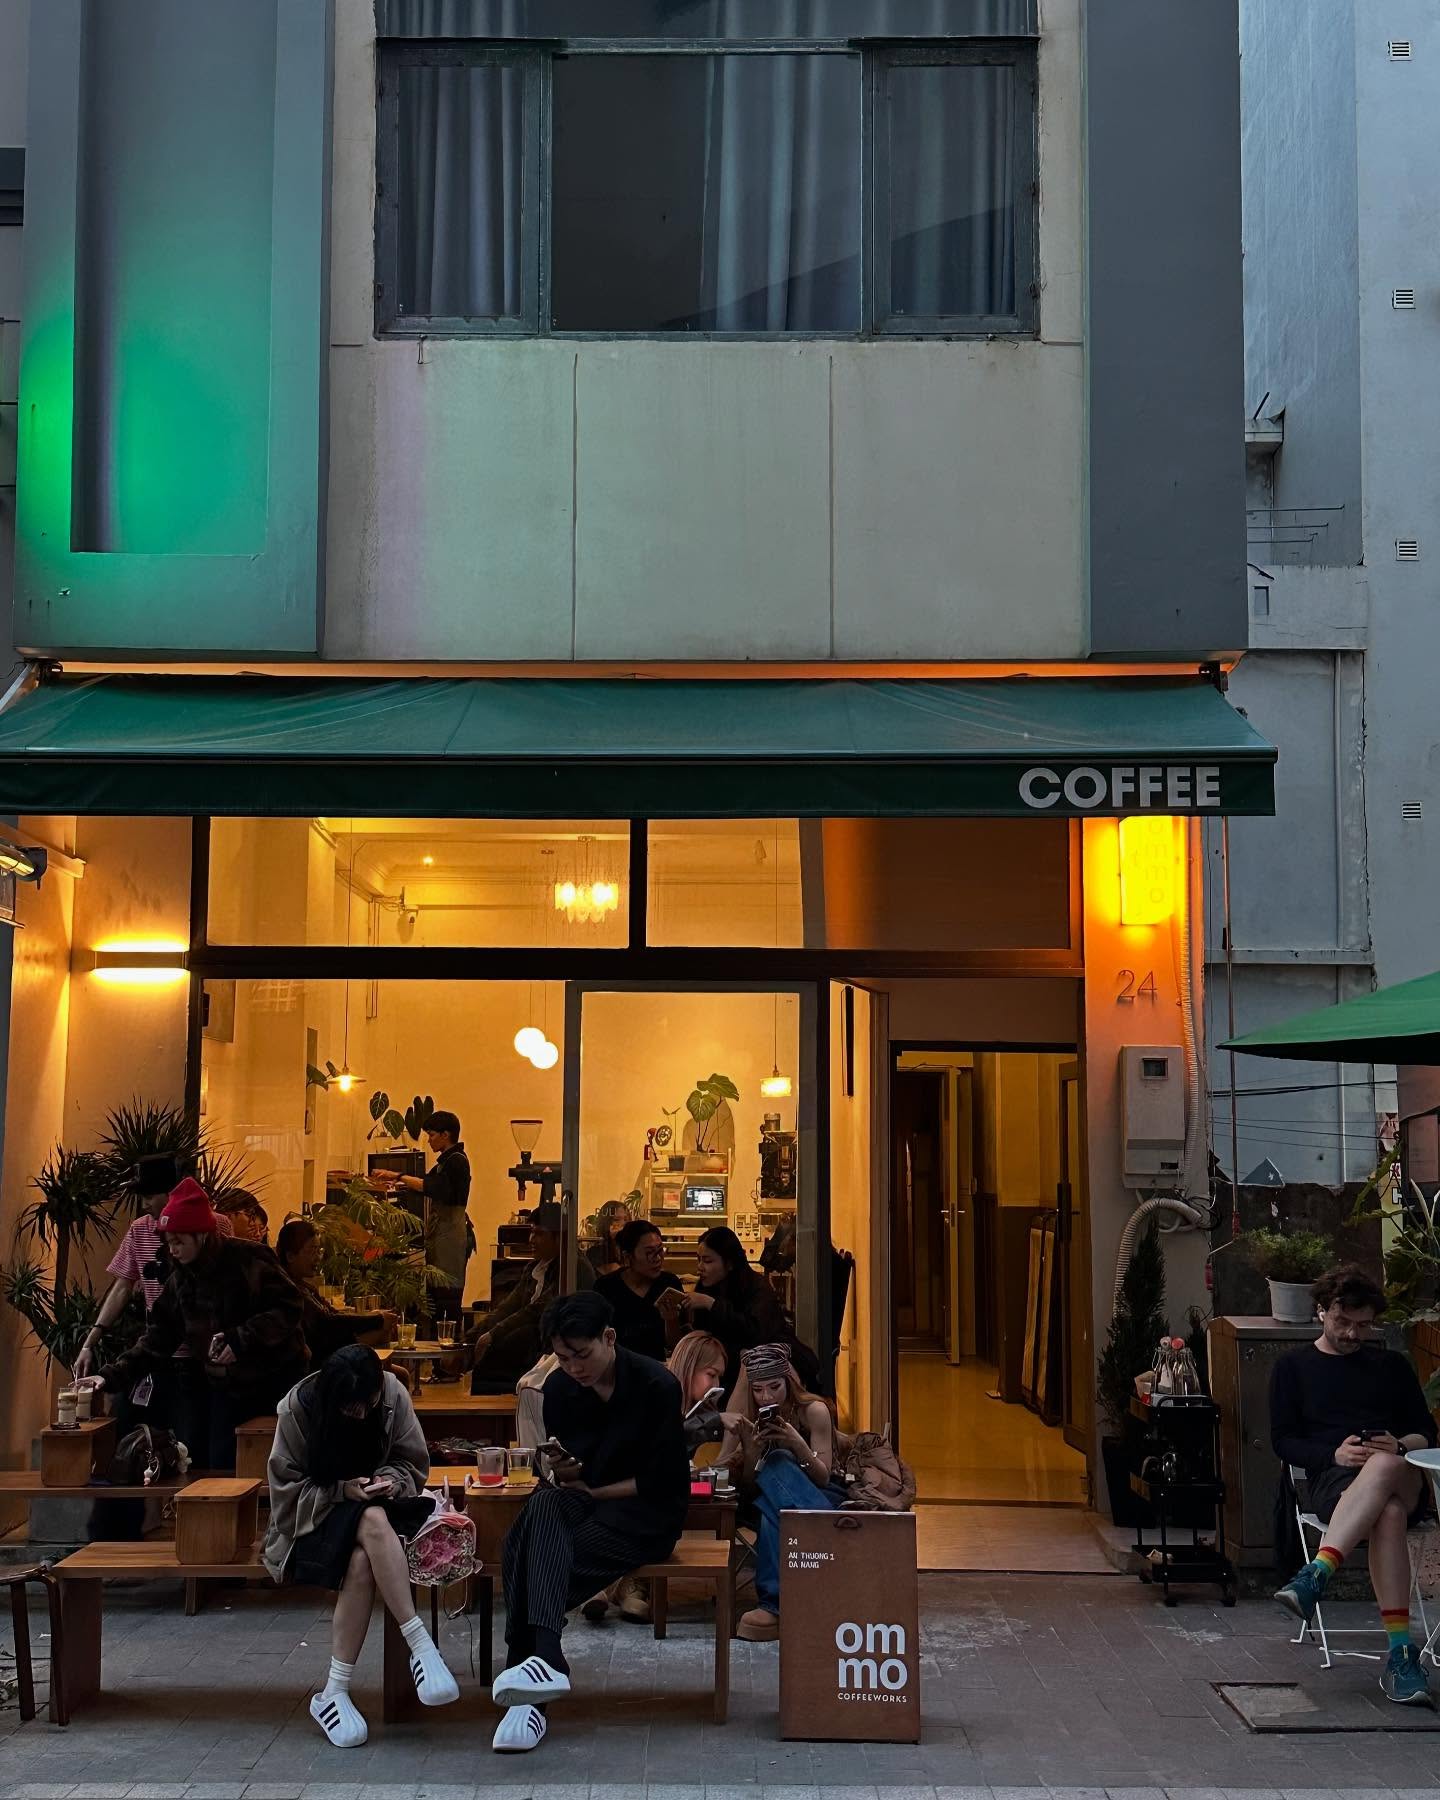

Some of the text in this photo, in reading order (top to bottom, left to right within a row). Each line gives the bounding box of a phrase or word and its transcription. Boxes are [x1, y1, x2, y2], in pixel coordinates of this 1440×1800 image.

[1018, 766, 1221, 808] COFFEE
[1116, 969, 1158, 1003] 24
[788, 1537, 798, 1545] 24
[788, 1551, 798, 1559] AN
[800, 1561, 820, 1569] NANG
[835, 1622, 906, 1655] om
[838, 1657, 908, 1690] mo
[837, 1692, 907, 1703] COFFEEWORKS
